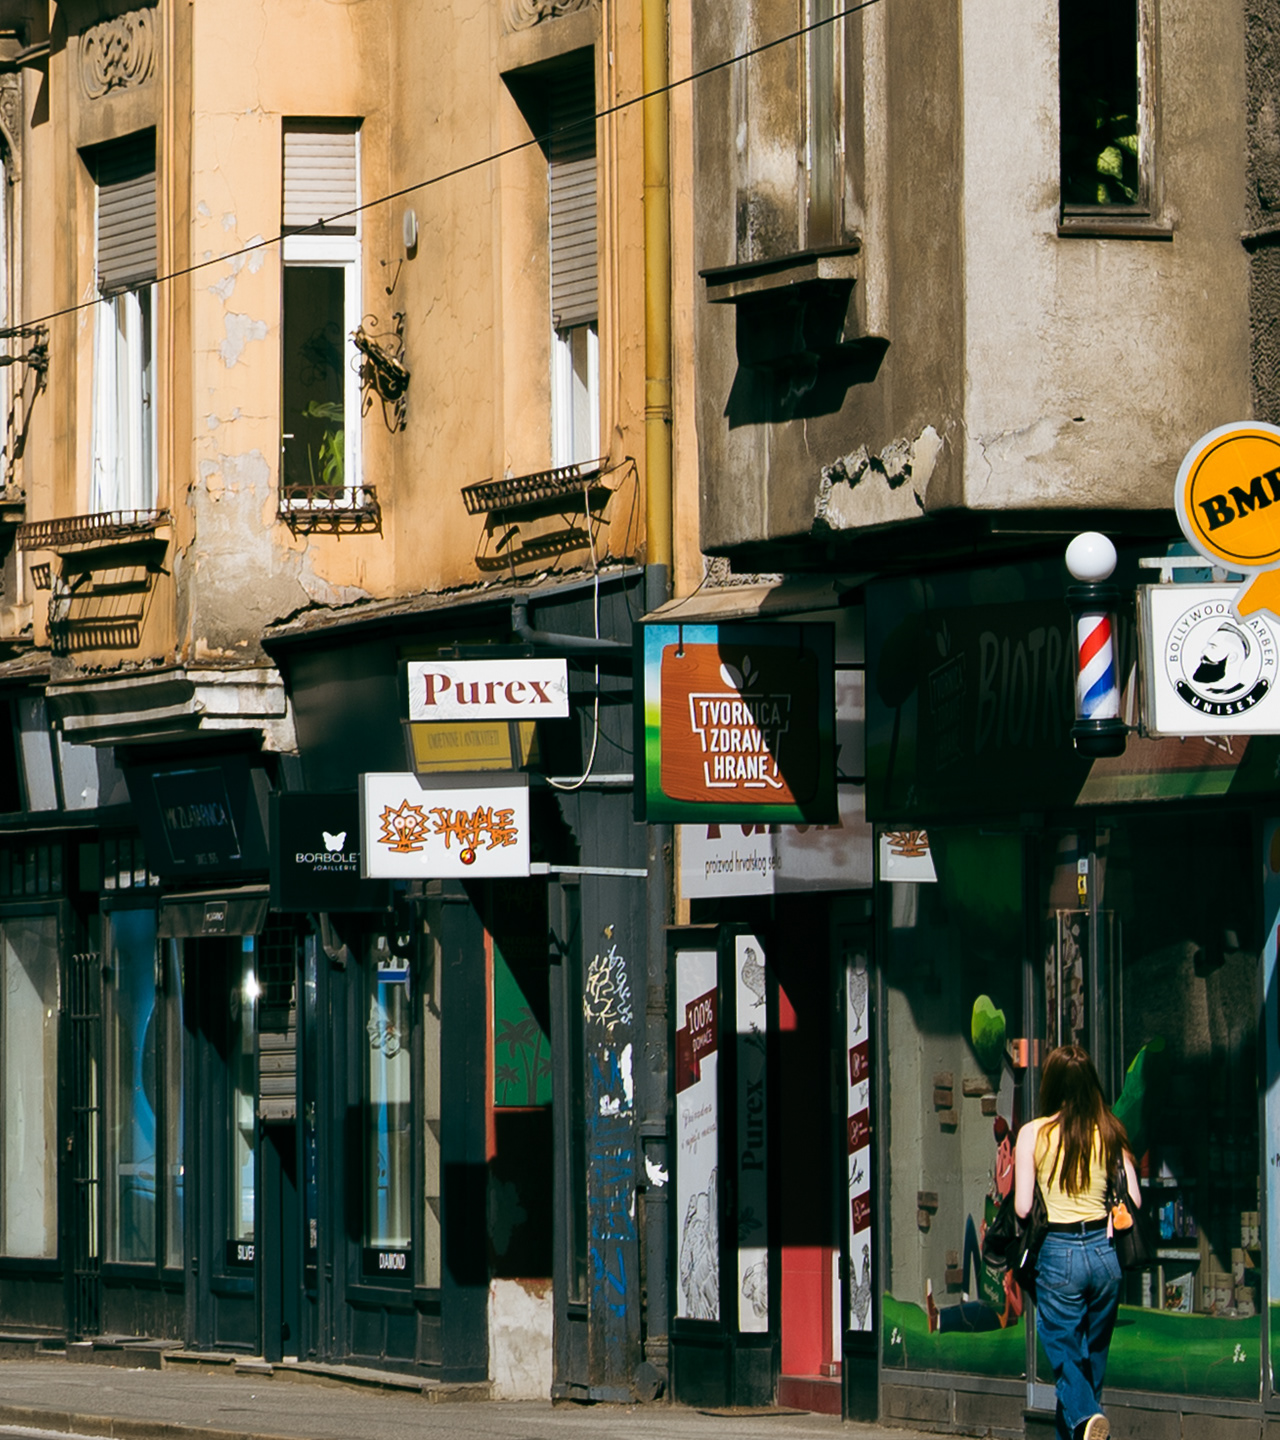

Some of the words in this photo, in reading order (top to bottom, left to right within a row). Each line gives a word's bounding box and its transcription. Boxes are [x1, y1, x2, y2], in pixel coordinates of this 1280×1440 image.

[423, 673, 553, 705] Purex
[699, 701, 781, 725] TVORNICA
[1191, 696, 1255, 715] UNISEX
[710, 729, 771, 752] ZDRAVE
[714, 756, 768, 780] HRANE
[296, 853, 360, 863] BORBOLE
[689, 998, 713, 1035] 100%
[742, 1079, 764, 1171] Purex
